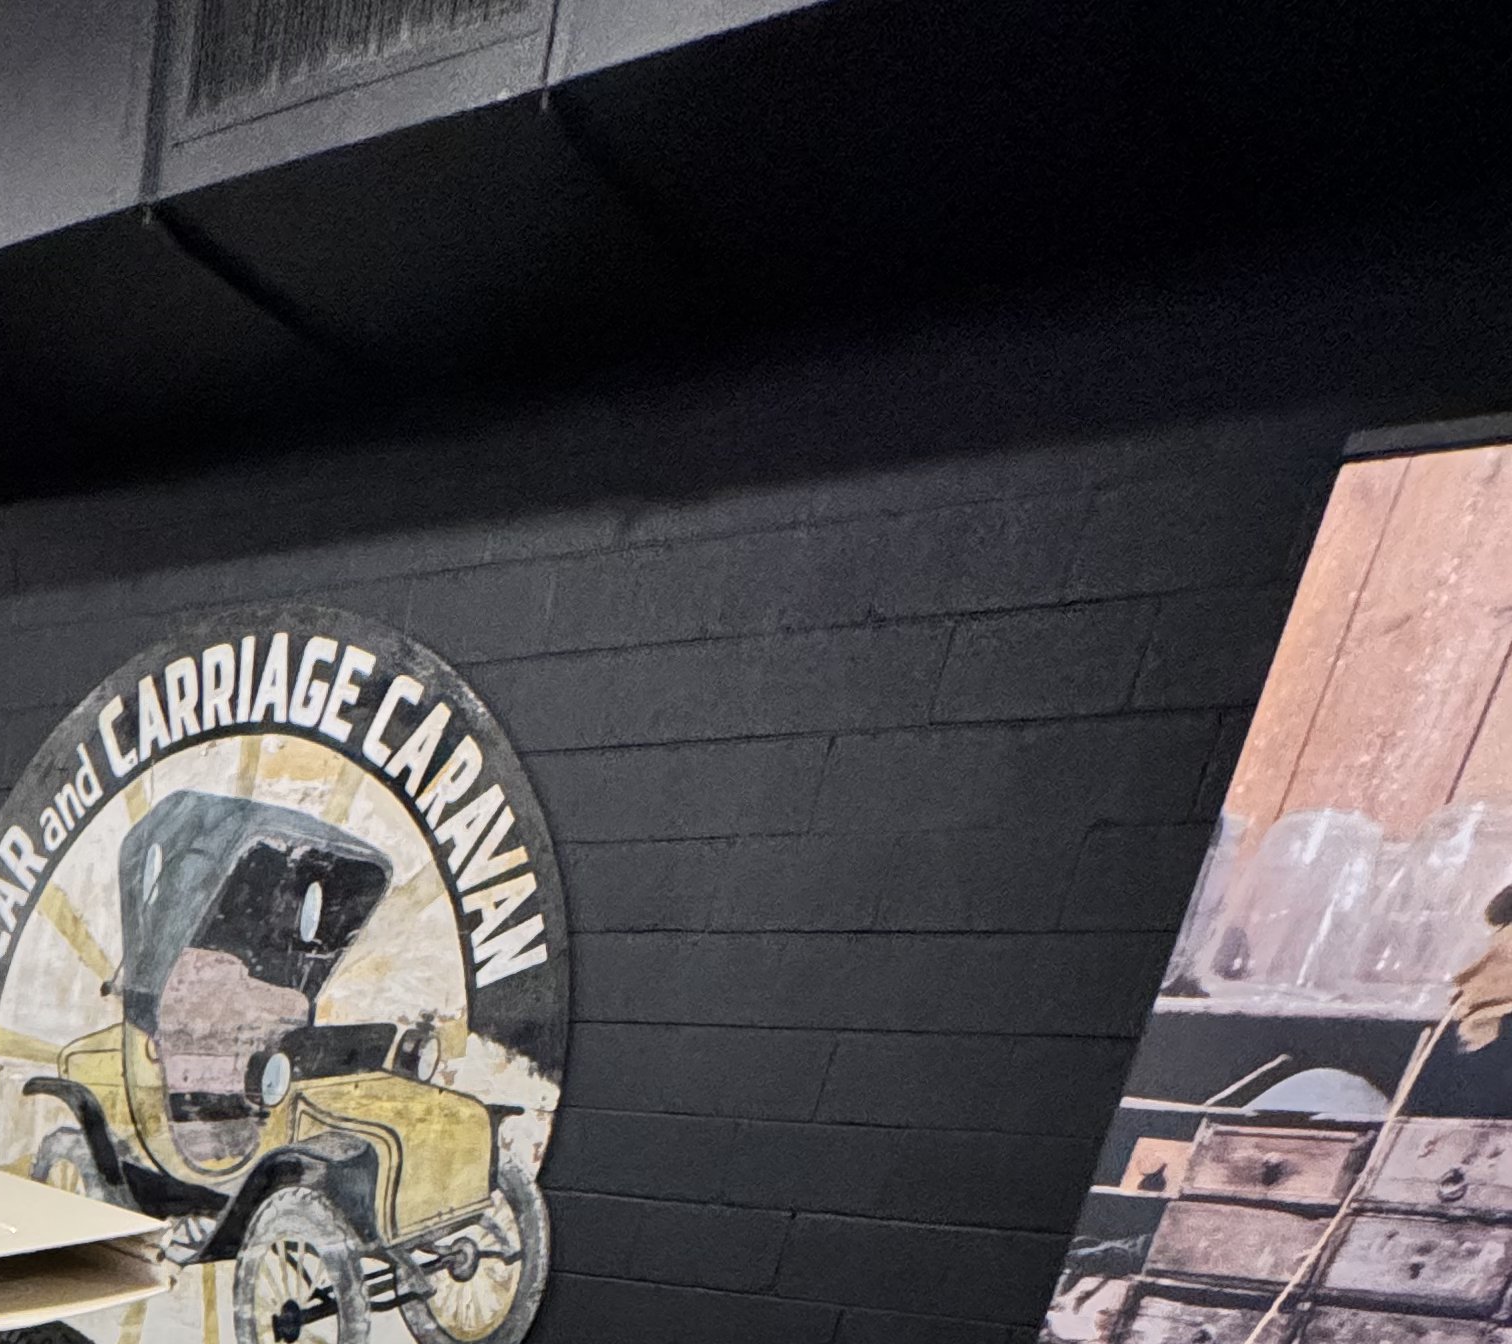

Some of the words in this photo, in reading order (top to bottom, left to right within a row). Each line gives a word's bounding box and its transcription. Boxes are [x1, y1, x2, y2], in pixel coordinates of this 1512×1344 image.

[39, 743, 104, 852] and
[99, 632, 377, 778] CARRIAGE
[362, 674, 548, 988] CARAVAN
